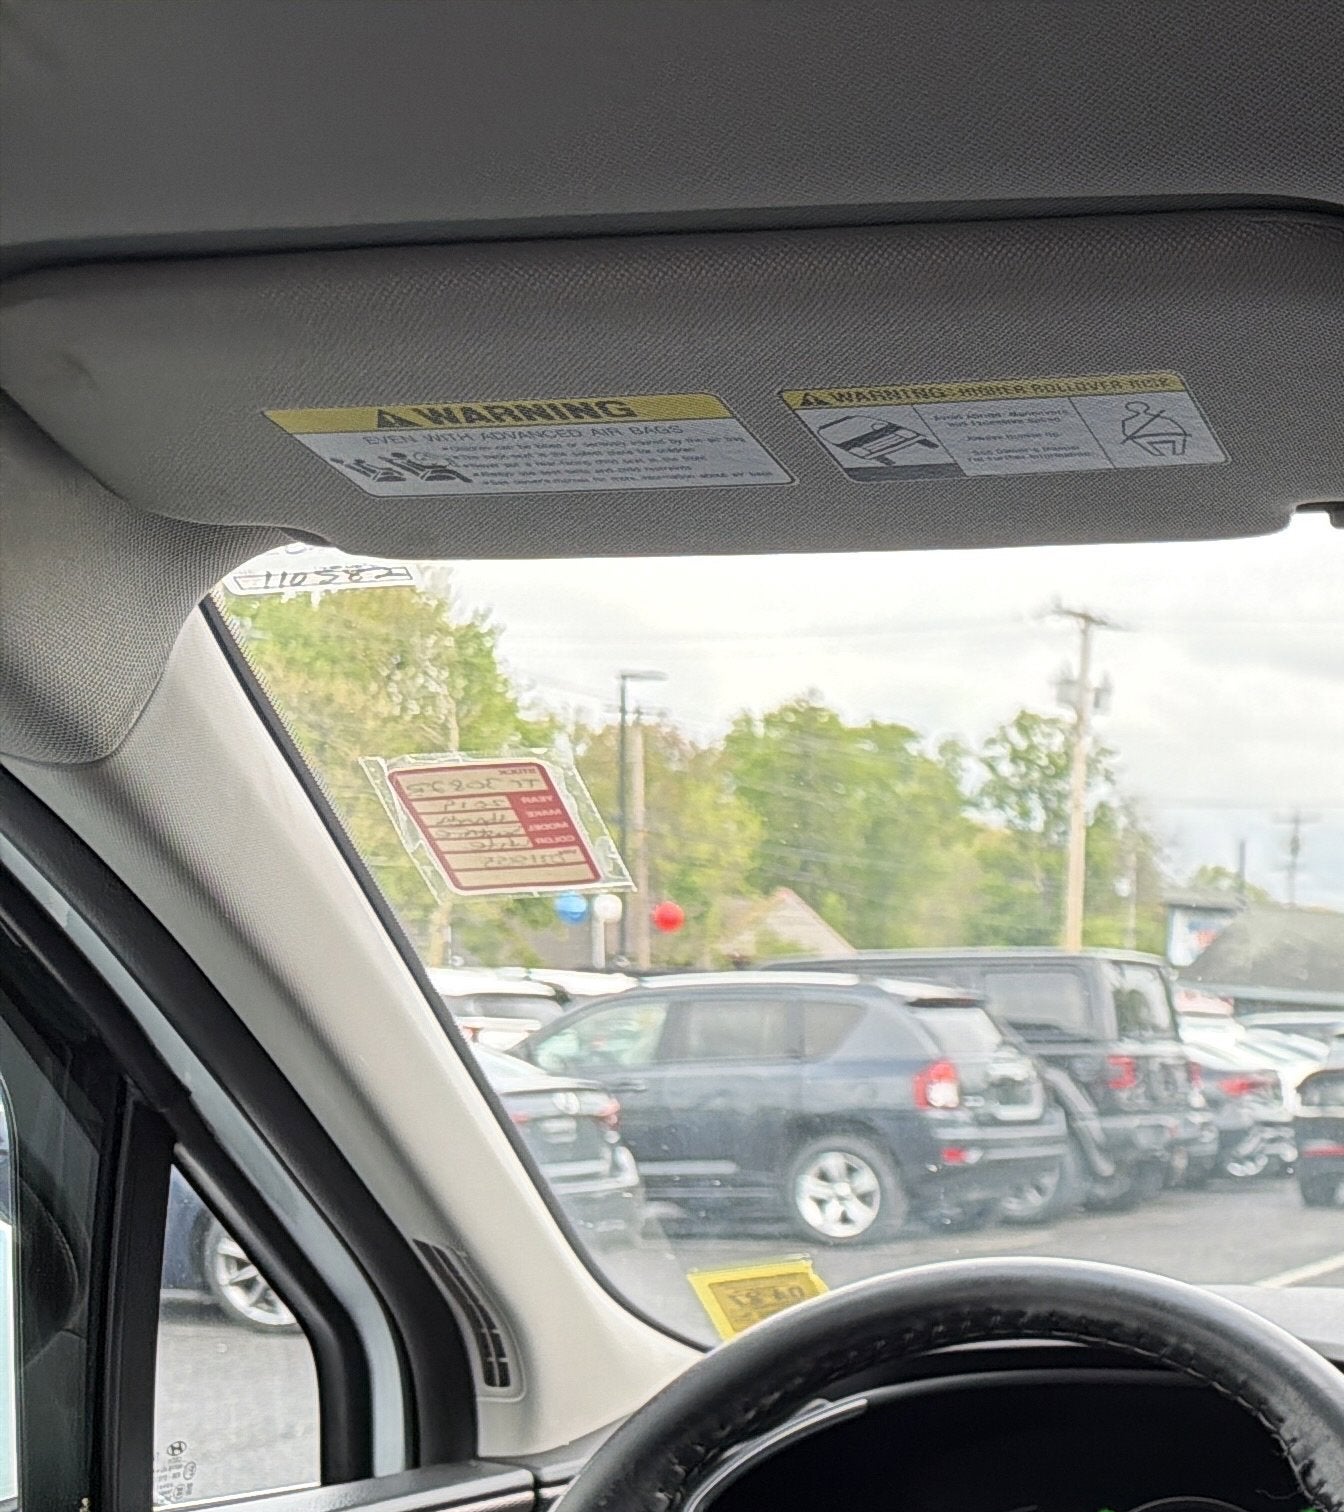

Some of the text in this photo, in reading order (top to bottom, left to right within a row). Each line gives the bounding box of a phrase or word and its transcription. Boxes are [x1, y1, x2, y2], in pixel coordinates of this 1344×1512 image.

[411, 399, 638, 425] WARNING
[362, 424, 685, 446] EVEN WITH ADVANCED AIR BAGS
